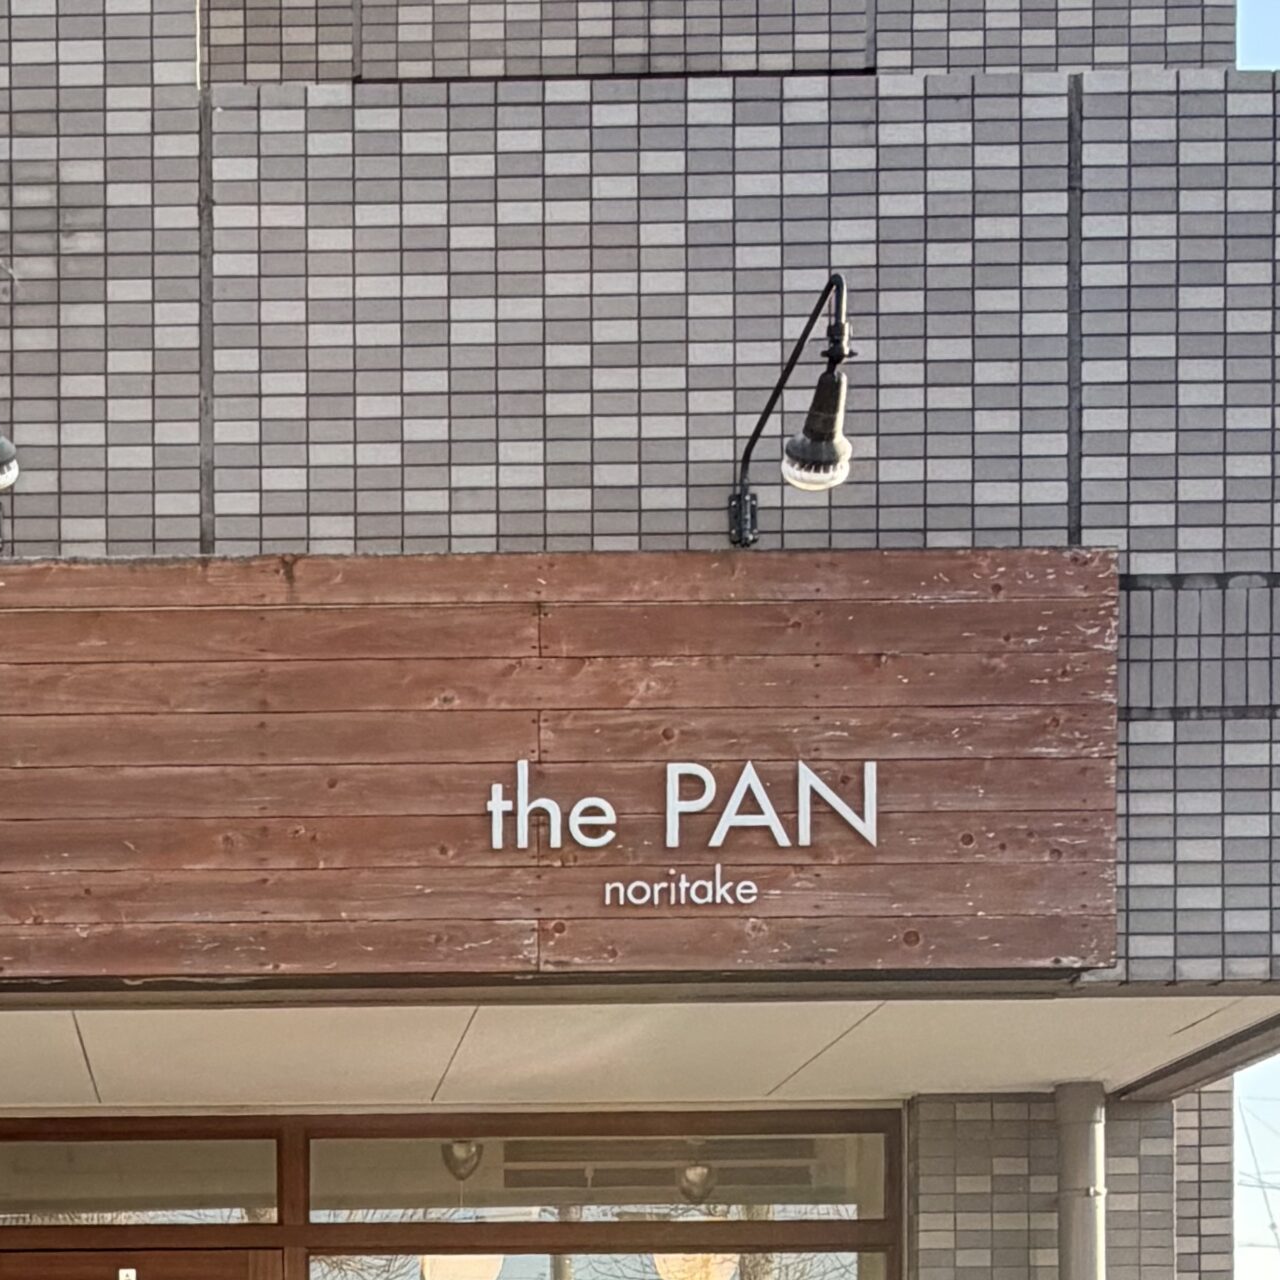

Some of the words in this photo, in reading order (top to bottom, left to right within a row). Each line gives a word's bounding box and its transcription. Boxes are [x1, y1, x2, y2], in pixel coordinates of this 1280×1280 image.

[486, 758, 617, 849] the
[665, 760, 878, 848] PAN
[604, 863, 759, 906] noritake
